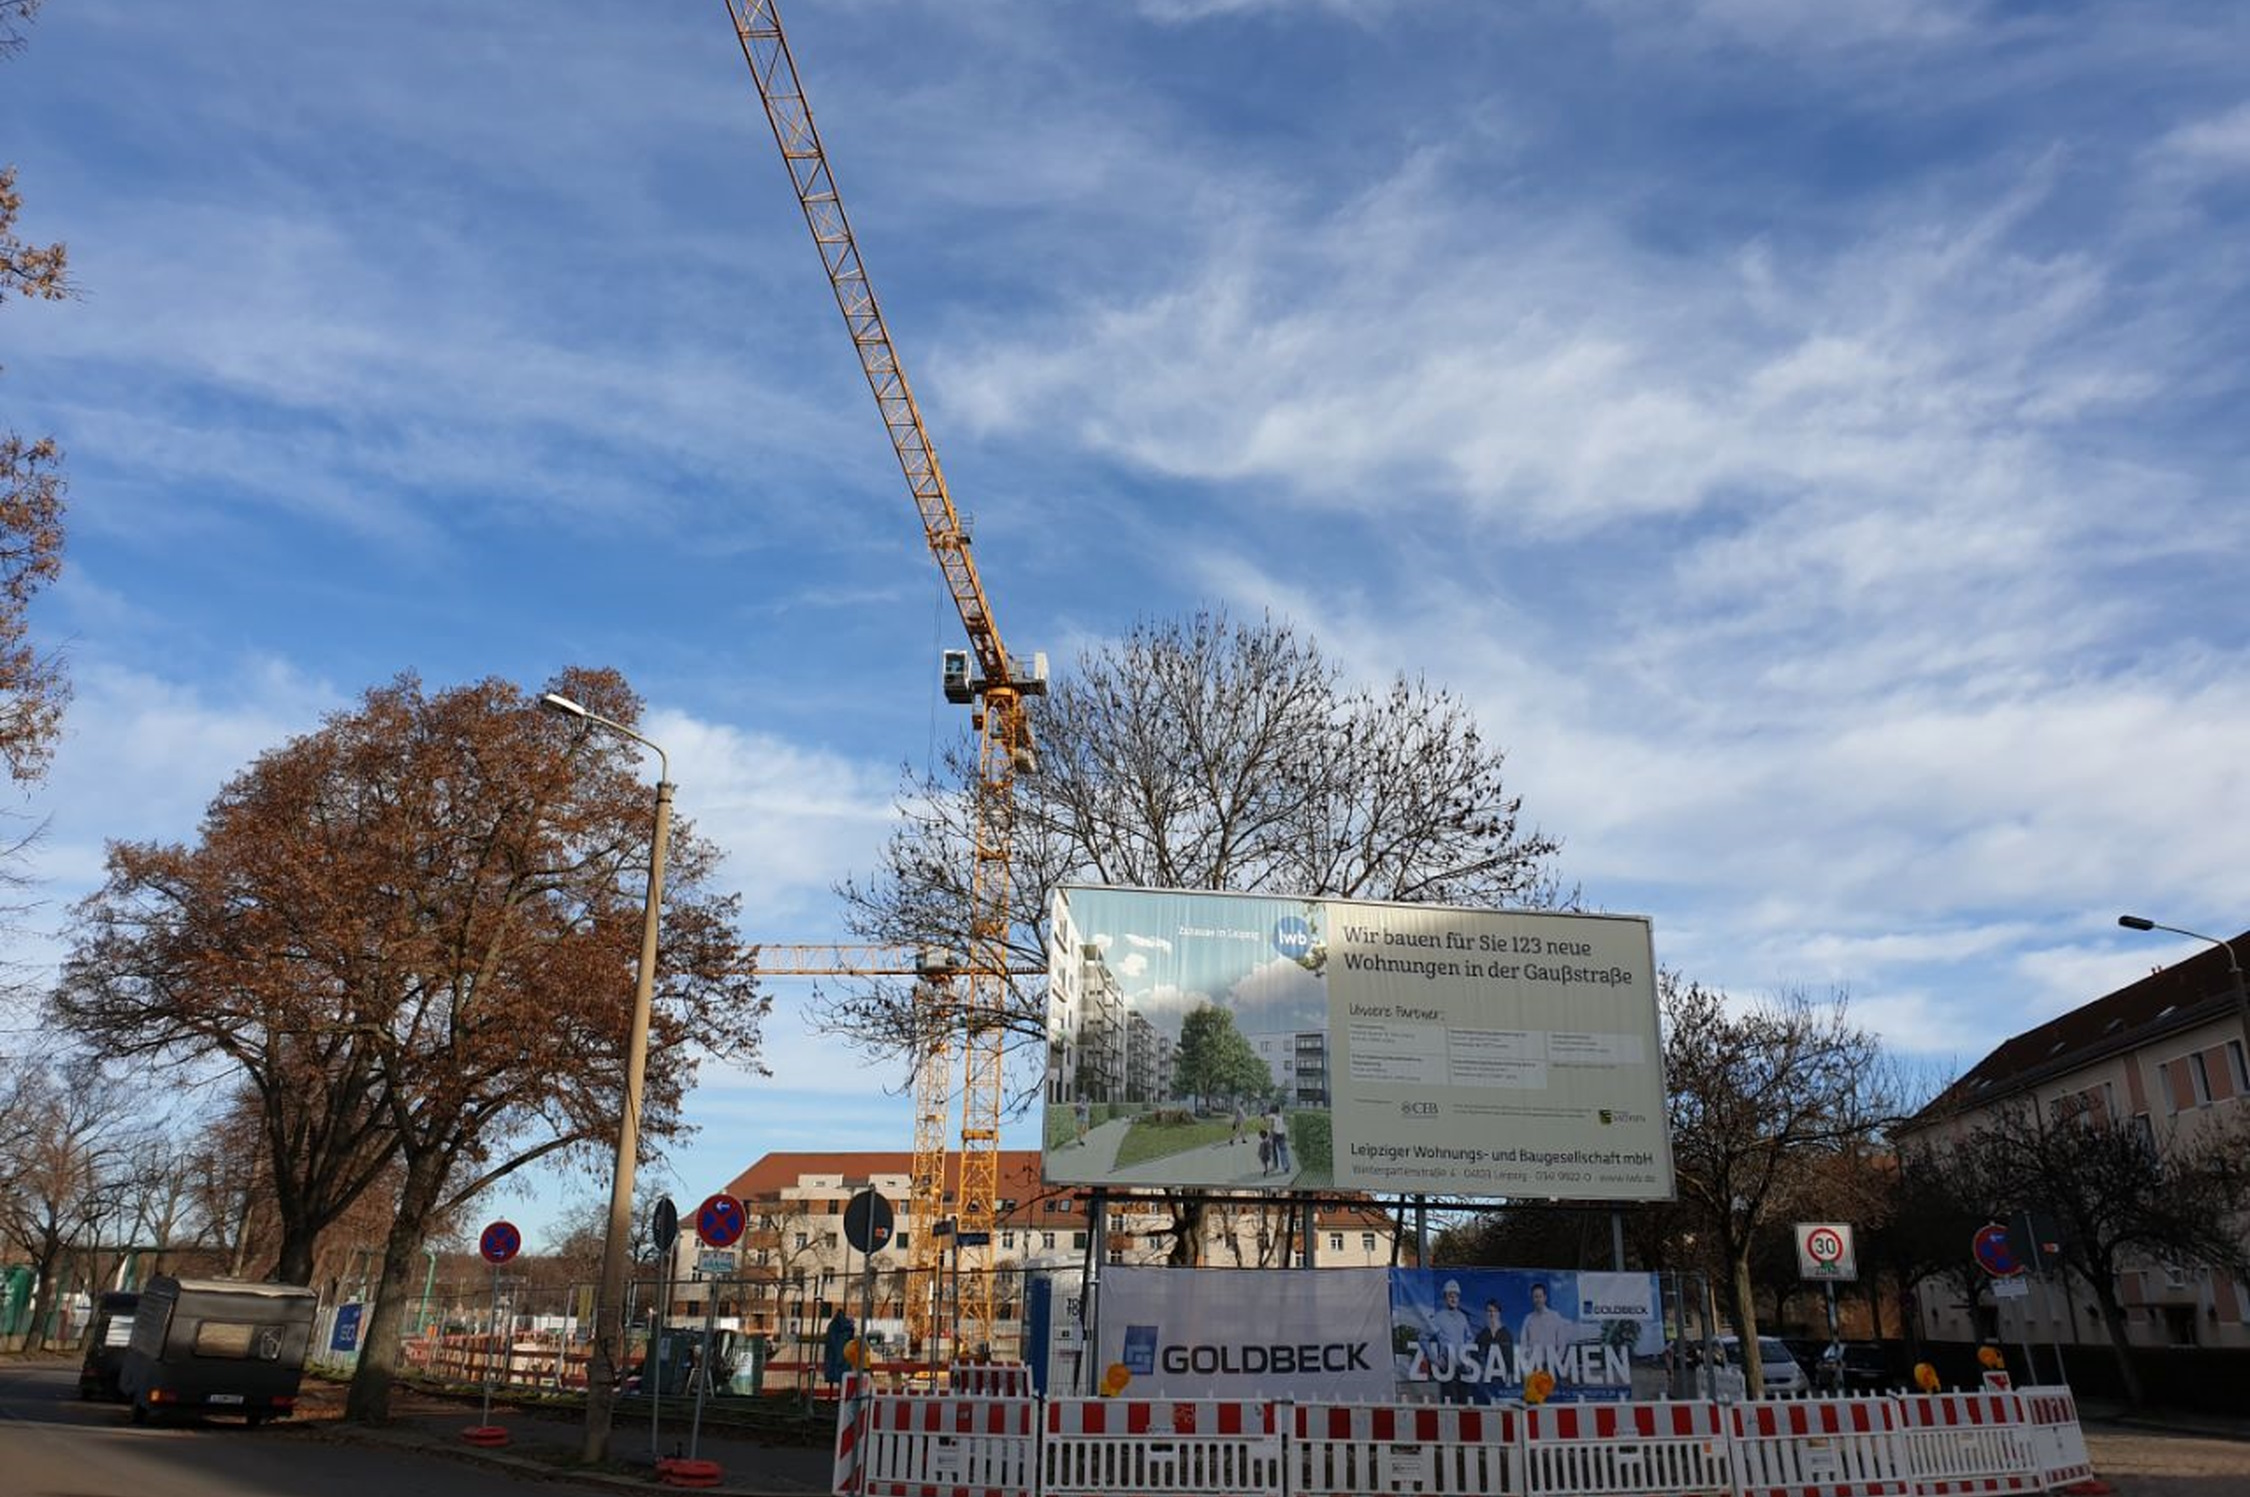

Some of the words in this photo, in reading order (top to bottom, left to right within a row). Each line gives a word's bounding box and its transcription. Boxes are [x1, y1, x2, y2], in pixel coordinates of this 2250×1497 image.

[1278, 927, 1308, 946] lwb
[1344, 926, 1379, 944] Wir
[1383, 929, 1442, 948] bauen
[1446, 931, 1476, 950] für
[1479, 934, 1508, 953] Sie
[1512, 936, 1543, 955] 123
[1546, 940, 1592, 957] neue
[1343, 952, 1461, 979] Wohnungen
[1465, 959, 1484, 977] in
[1487, 961, 1519, 979] der
[1523, 963, 1633, 987] Gaußstraße
[1350, 1143, 1410, 1161] Leipziger
[1412, 1145, 1490, 1164] Wohnungs-
[1491, 1148, 1517, 1163] und
[1519, 1149, 1621, 1167] Baugesellschaft
[1623, 1151, 1654, 1165] mbH
[1815, 1237, 1836, 1255] 30
[1592, 1304, 1649, 1316] GOLDBECK
[1162, 1341, 1372, 1376] GOLDBECK
[1406, 1340, 1633, 1386] ZUSAMMEN
